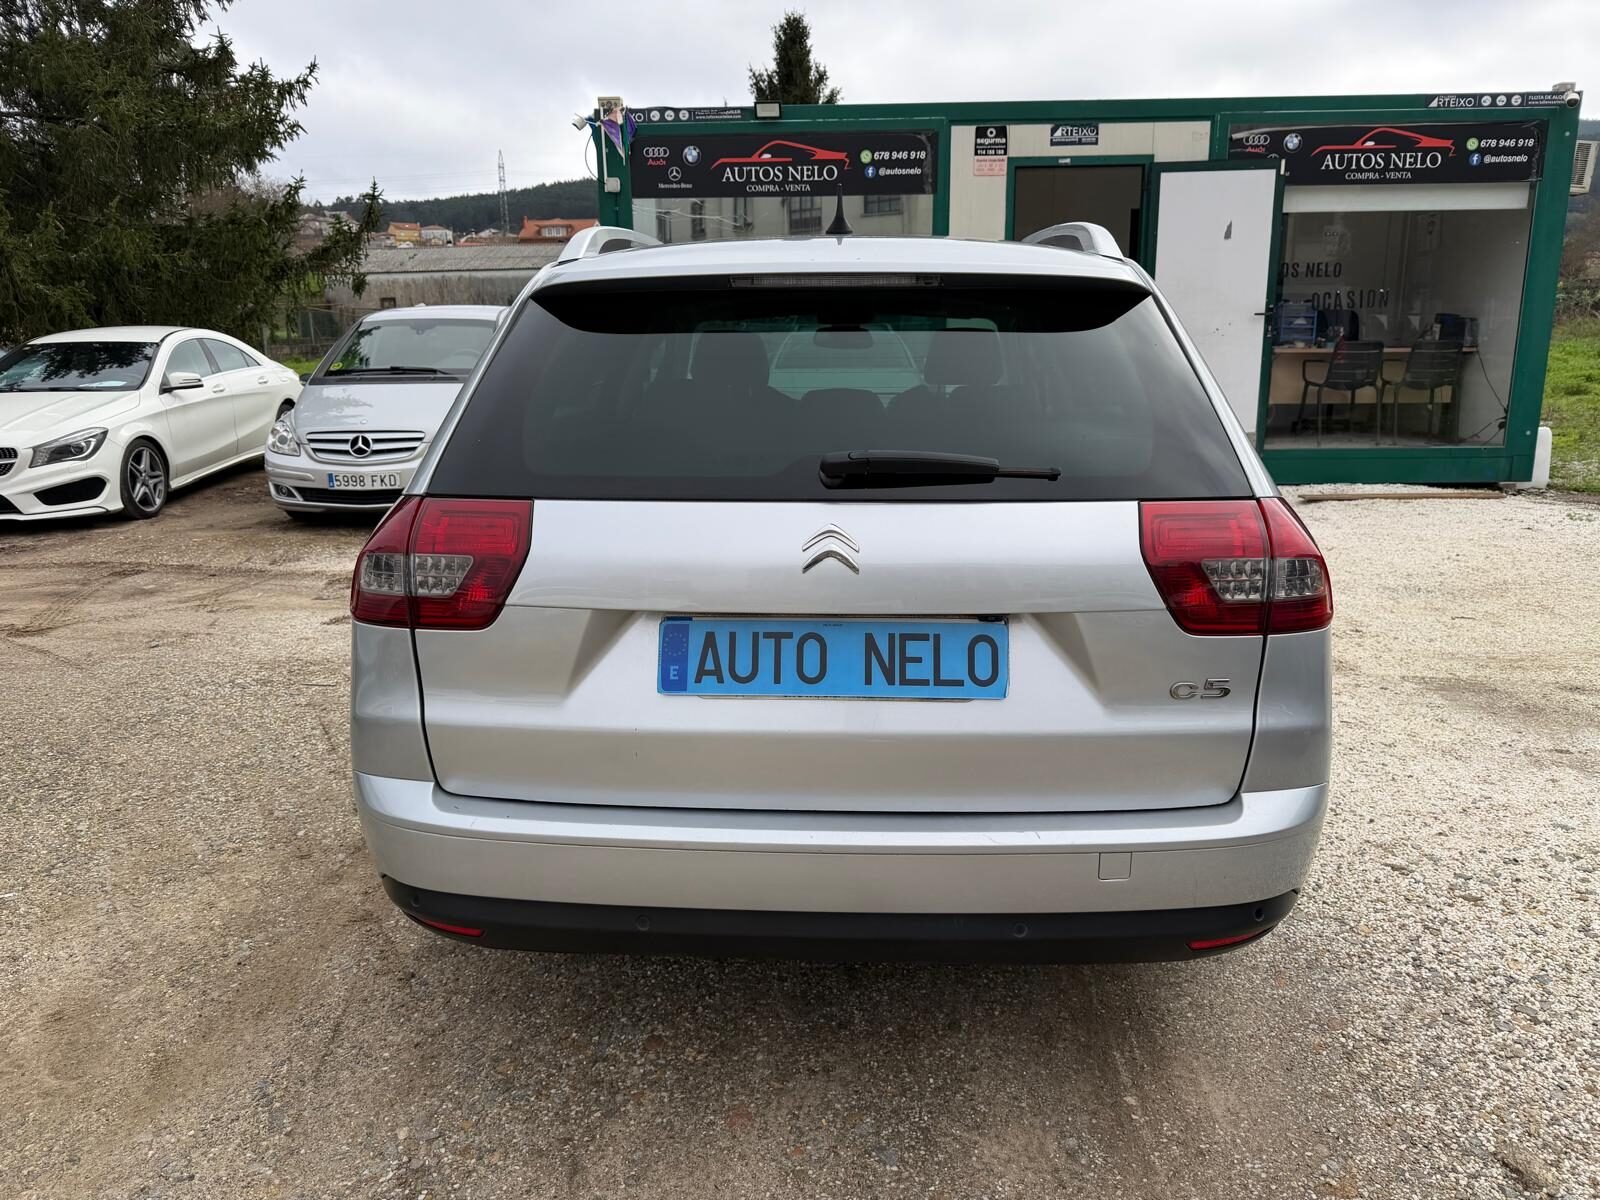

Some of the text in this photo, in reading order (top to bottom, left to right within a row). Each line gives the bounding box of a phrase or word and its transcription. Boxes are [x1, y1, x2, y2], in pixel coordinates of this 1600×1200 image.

[1480, 138, 1534, 147] 678 946 918
[873, 150, 926, 160] 678 946 918
[1321, 152, 1442, 170] AUTOS NELO
[1483, 154, 1528, 163] @autosnelo
[647, 158, 666, 166] Audi
[722, 165, 838, 182] AUTOS NELO
[878, 167, 922, 176] @autosnelo
[1345, 172, 1380, 180] COMPRA
[1385, 171, 1412, 179] VENTA
[746, 184, 780, 192] COMPRA
[1305, 262, 1342, 278] NELO
[1312, 289, 1390, 311] OCASION
[334, 474, 397, 487] 5998 FKD
[694, 631, 999, 687] AUTO NELO
[669, 665, 679, 680] E
[1170, 678, 1231, 699] C5
